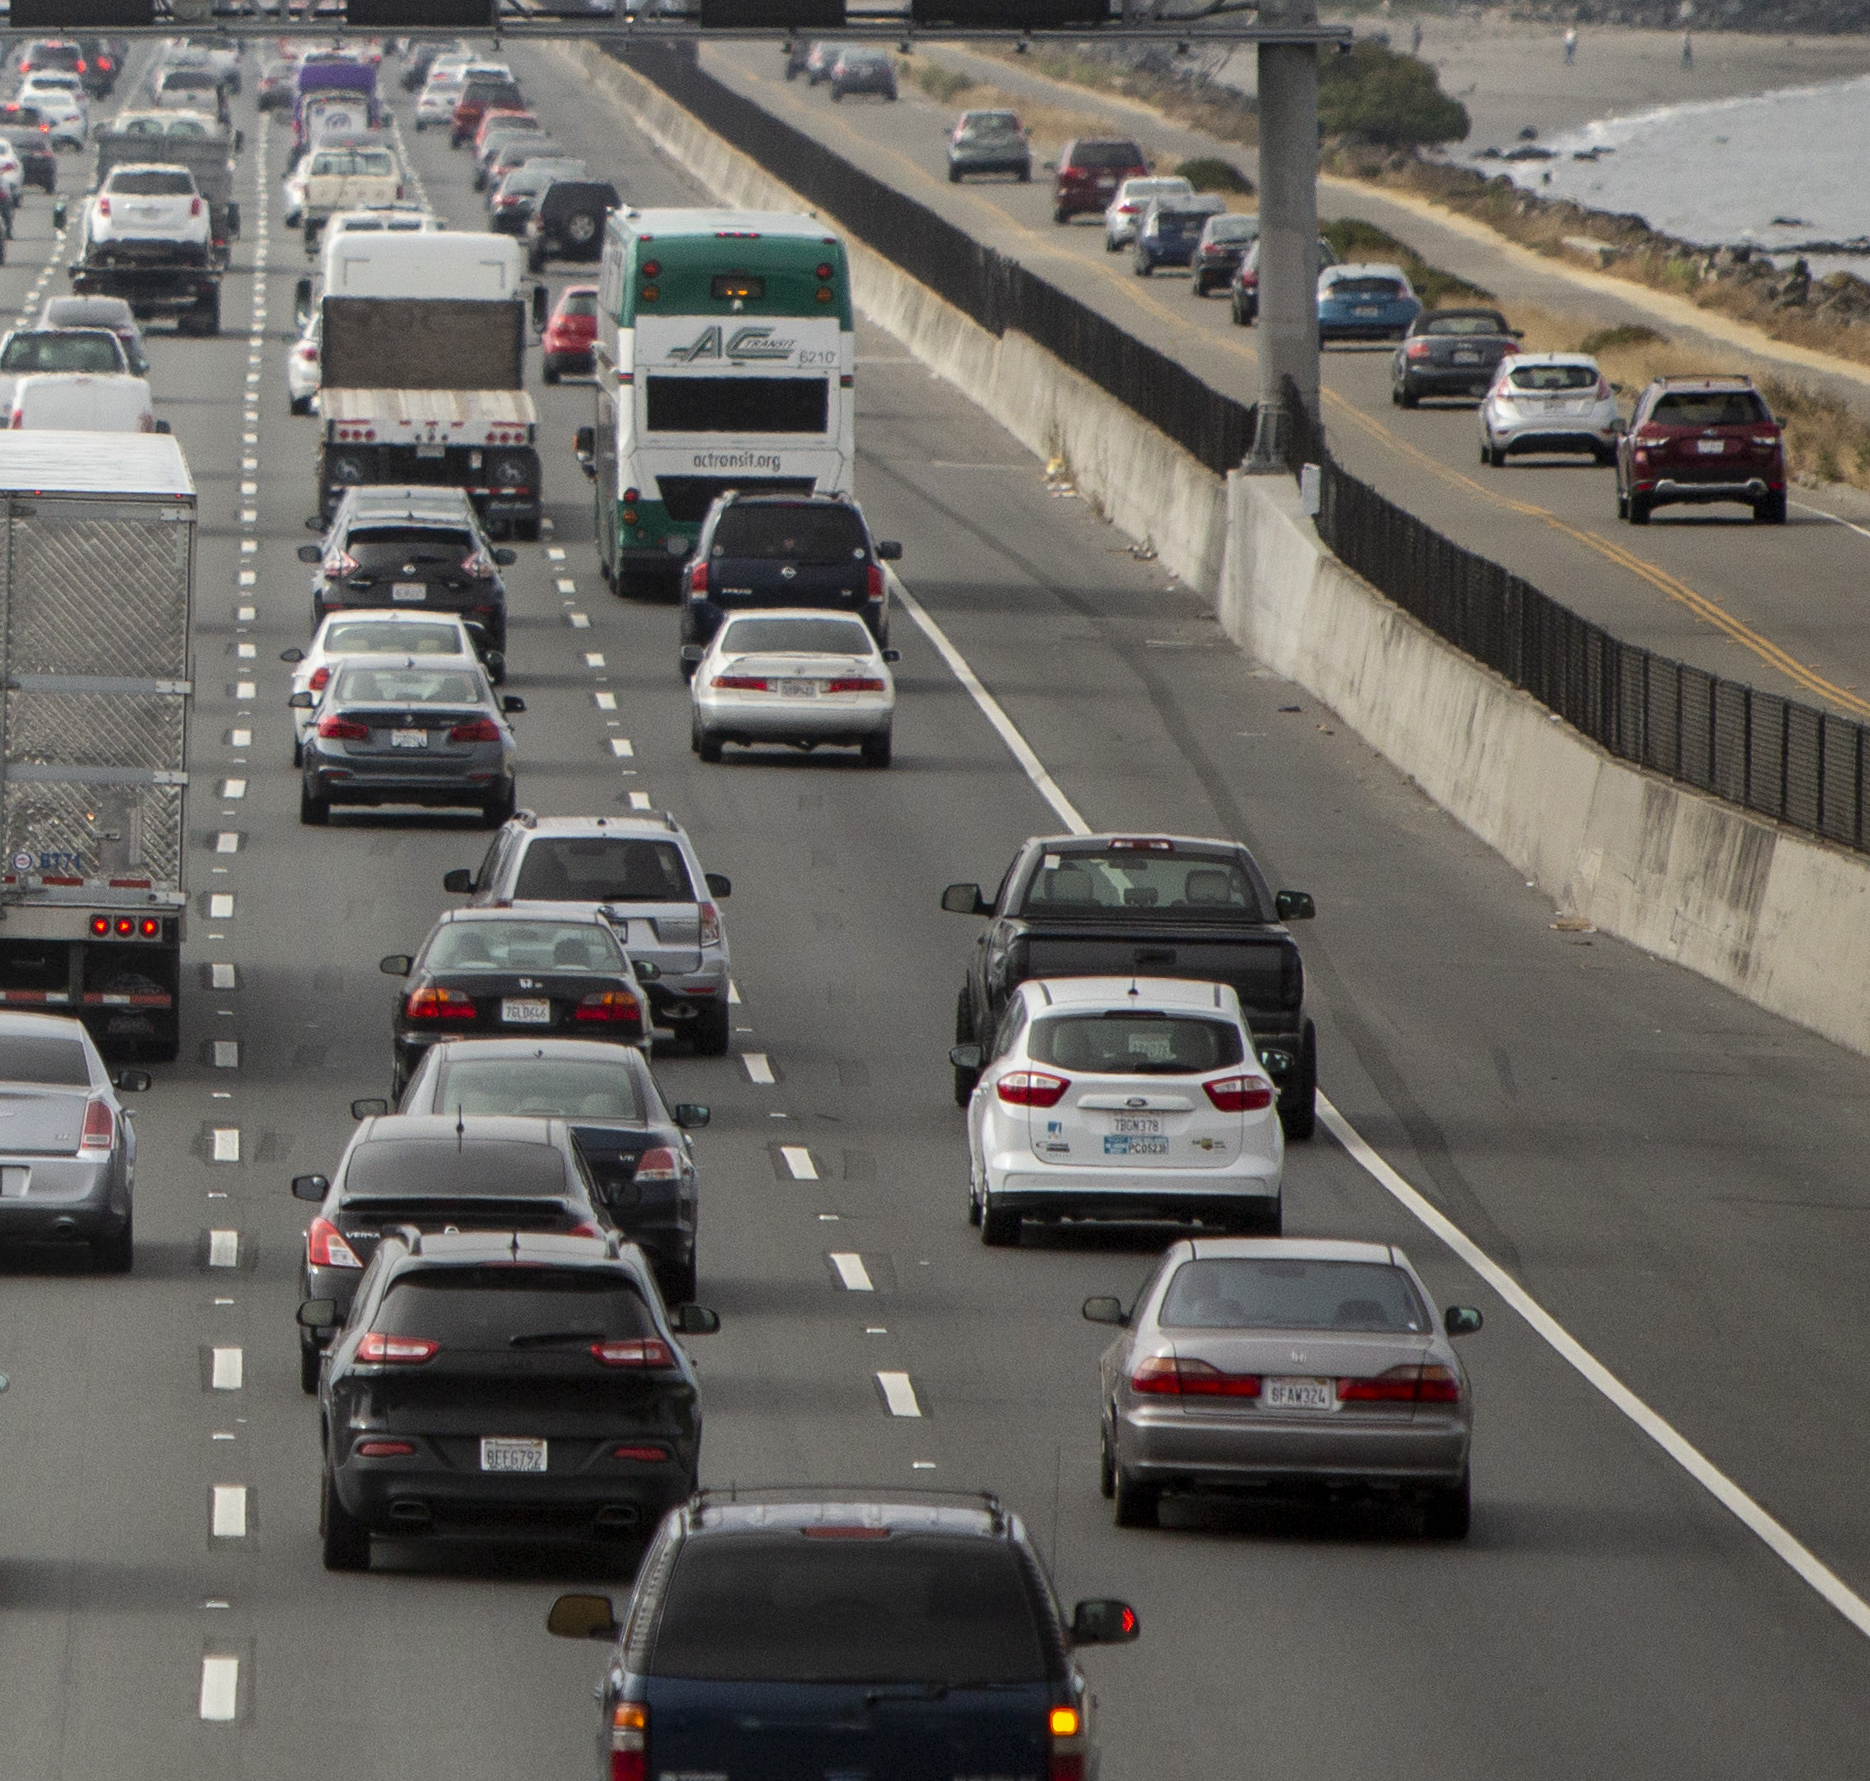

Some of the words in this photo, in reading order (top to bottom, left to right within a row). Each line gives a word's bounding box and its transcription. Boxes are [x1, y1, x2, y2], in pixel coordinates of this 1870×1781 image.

[667, 325, 794, 362] AC
[746, 339, 796, 348] TRANSIT
[799, 351, 835, 364] 6210
[693, 452, 781, 472] actransit.org
[1115, 1119, 1159, 1132] 7BGN378
